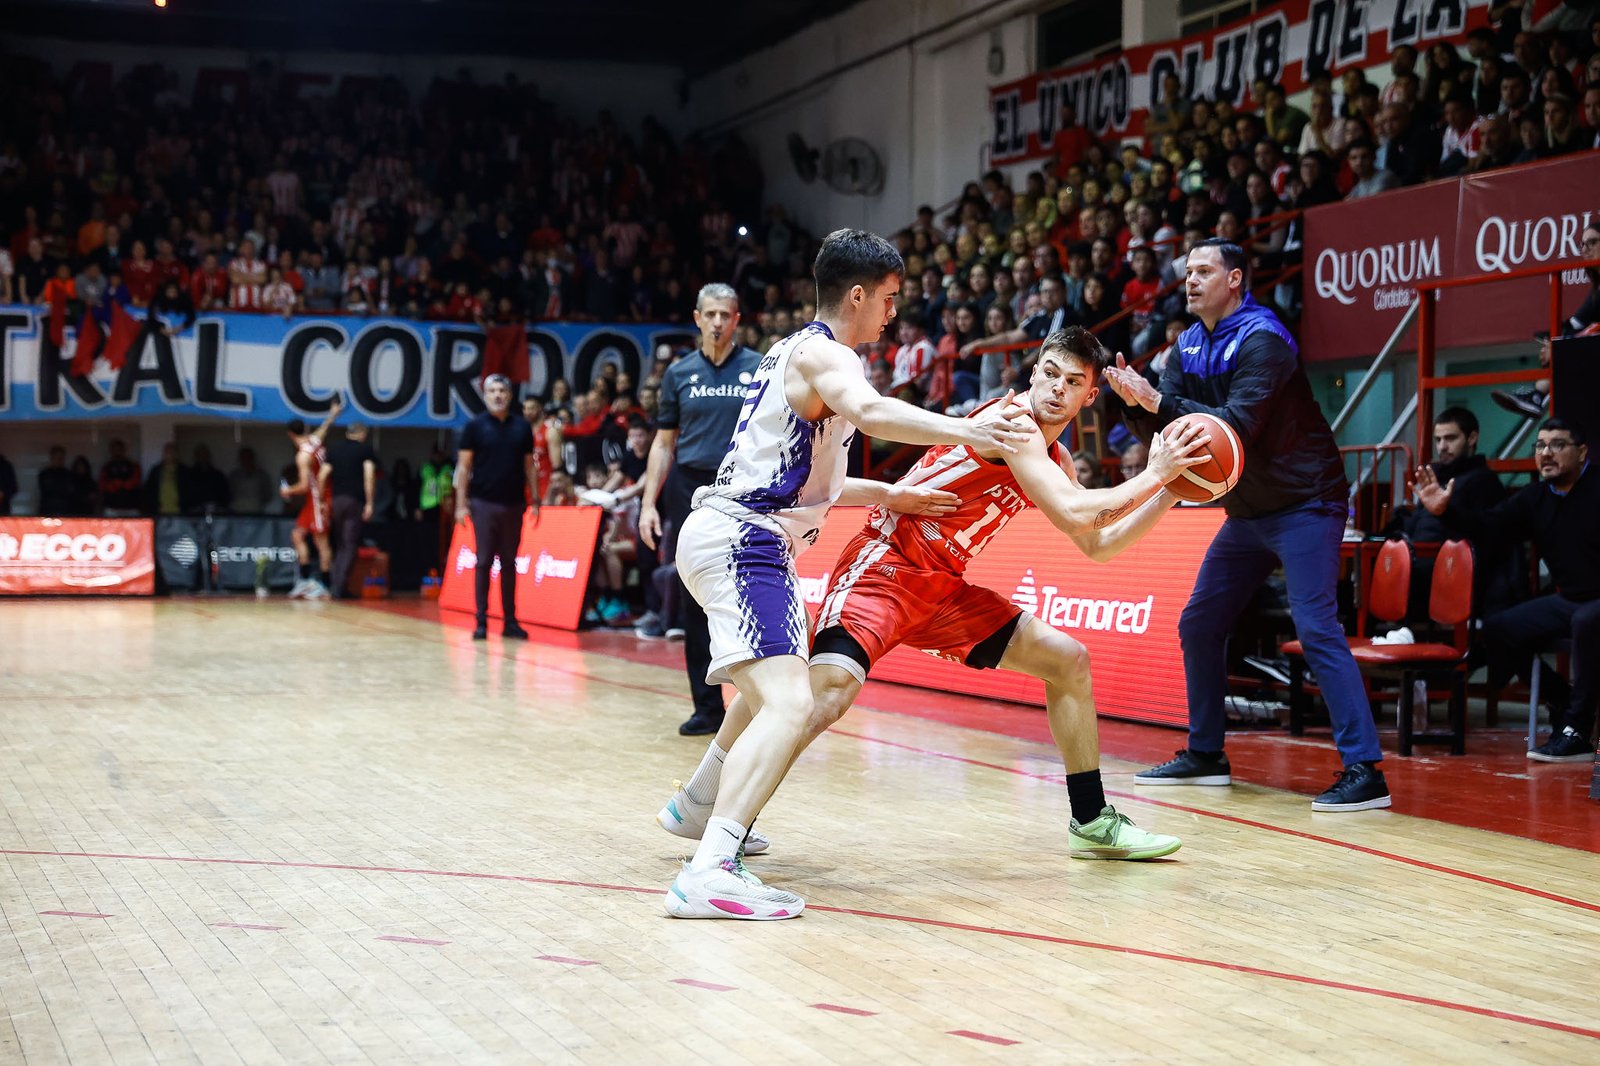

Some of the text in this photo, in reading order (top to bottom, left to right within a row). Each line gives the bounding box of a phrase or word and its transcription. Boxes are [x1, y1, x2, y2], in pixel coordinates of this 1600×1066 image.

[993, 91, 1027, 157] EL
[1304, 0, 1368, 80] DE
[1315, 235, 1443, 305] QUORUM
[20, 532, 127, 561] ECCO
[214, 546, 298, 562] ecnore
[1040, 585, 1155, 635] Tecnored
